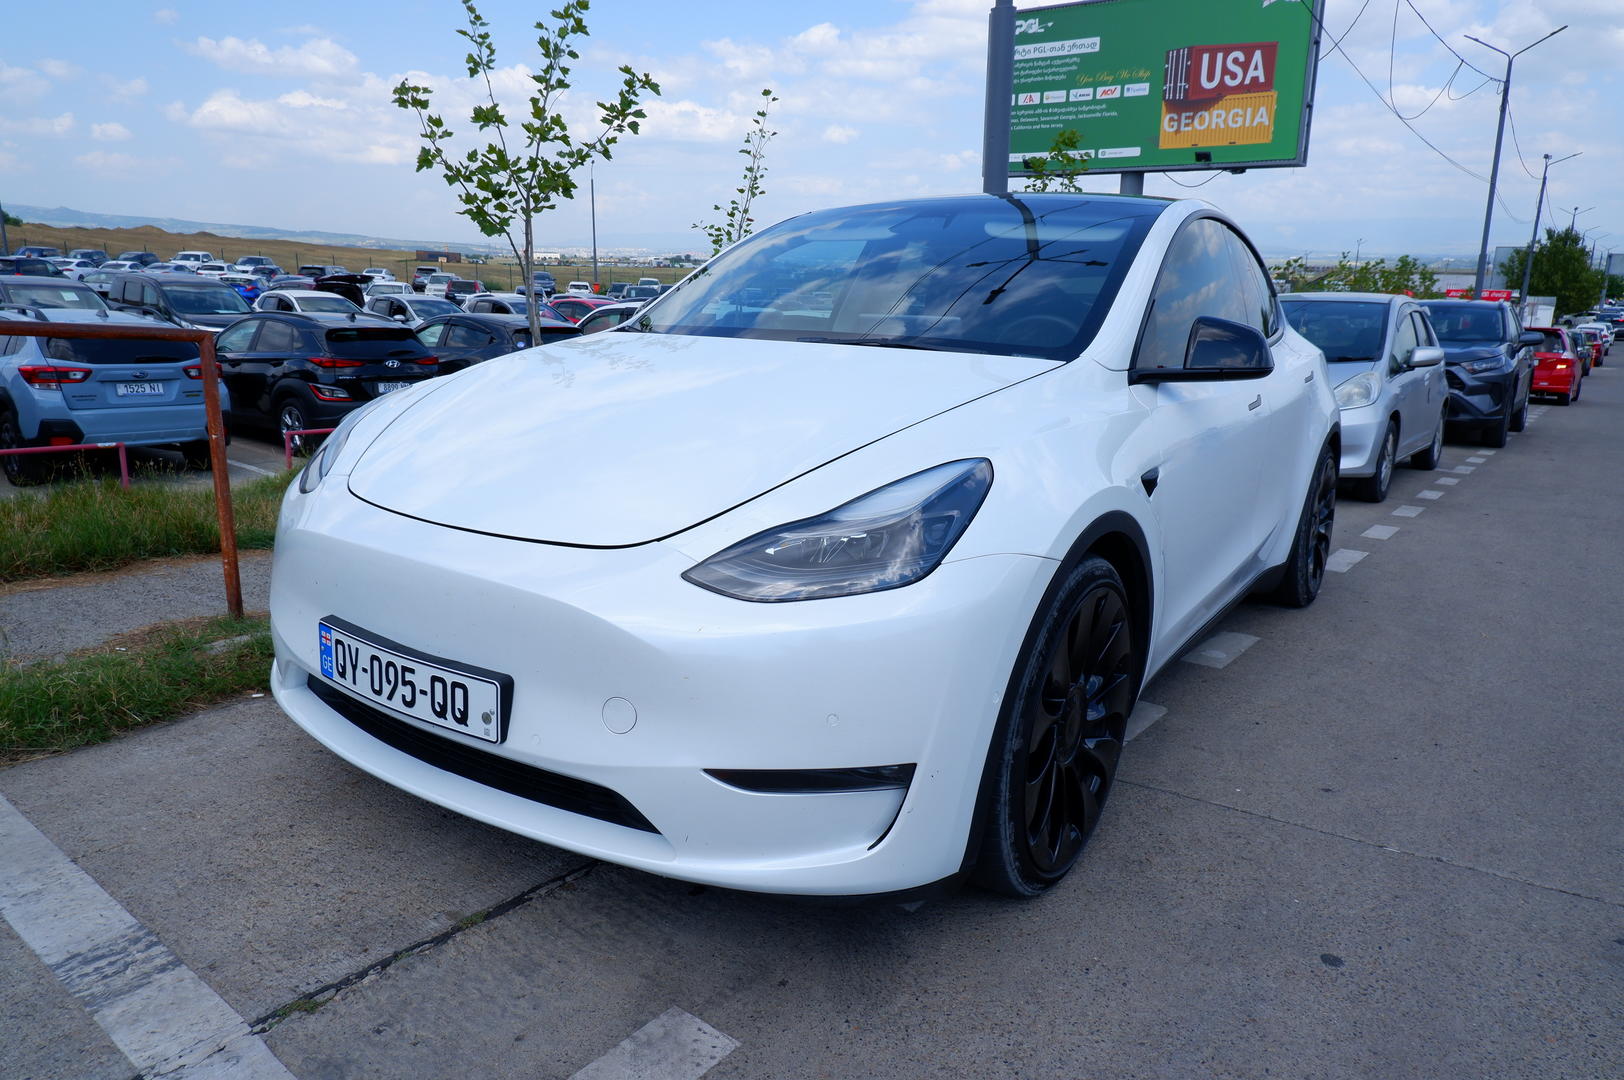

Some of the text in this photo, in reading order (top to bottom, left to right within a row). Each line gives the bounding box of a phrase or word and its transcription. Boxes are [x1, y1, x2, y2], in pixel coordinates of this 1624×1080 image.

[1015, 18, 1045, 35] PGL
[1066, 41, 1098, 53] ერთად
[1200, 49, 1266, 90] USA
[1163, 106, 1269, 133] GEORGIA
[124, 383, 160, 394] 1525 NI
[321, 654, 333, 672] GE
[334, 638, 469, 727] QY-095-QQ
